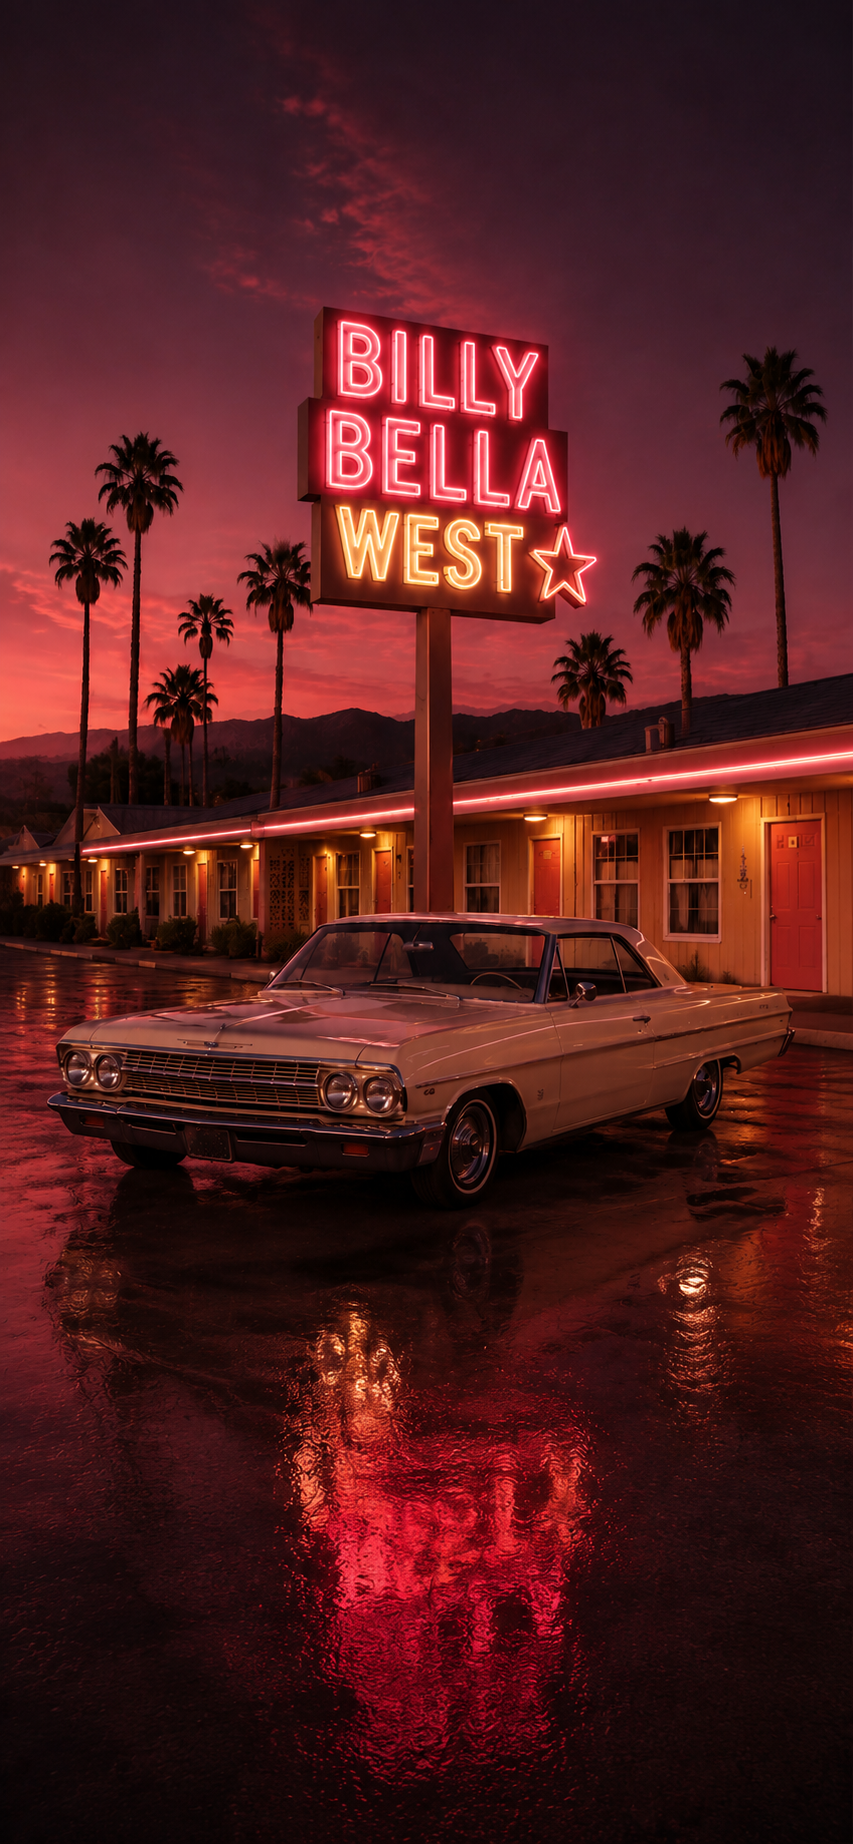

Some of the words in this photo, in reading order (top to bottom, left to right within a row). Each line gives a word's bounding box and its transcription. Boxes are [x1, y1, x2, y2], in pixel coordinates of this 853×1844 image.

[337, 321, 539, 421] BILLY
[325, 409, 561, 514] BELLA
[334, 505, 524, 593] WEST
